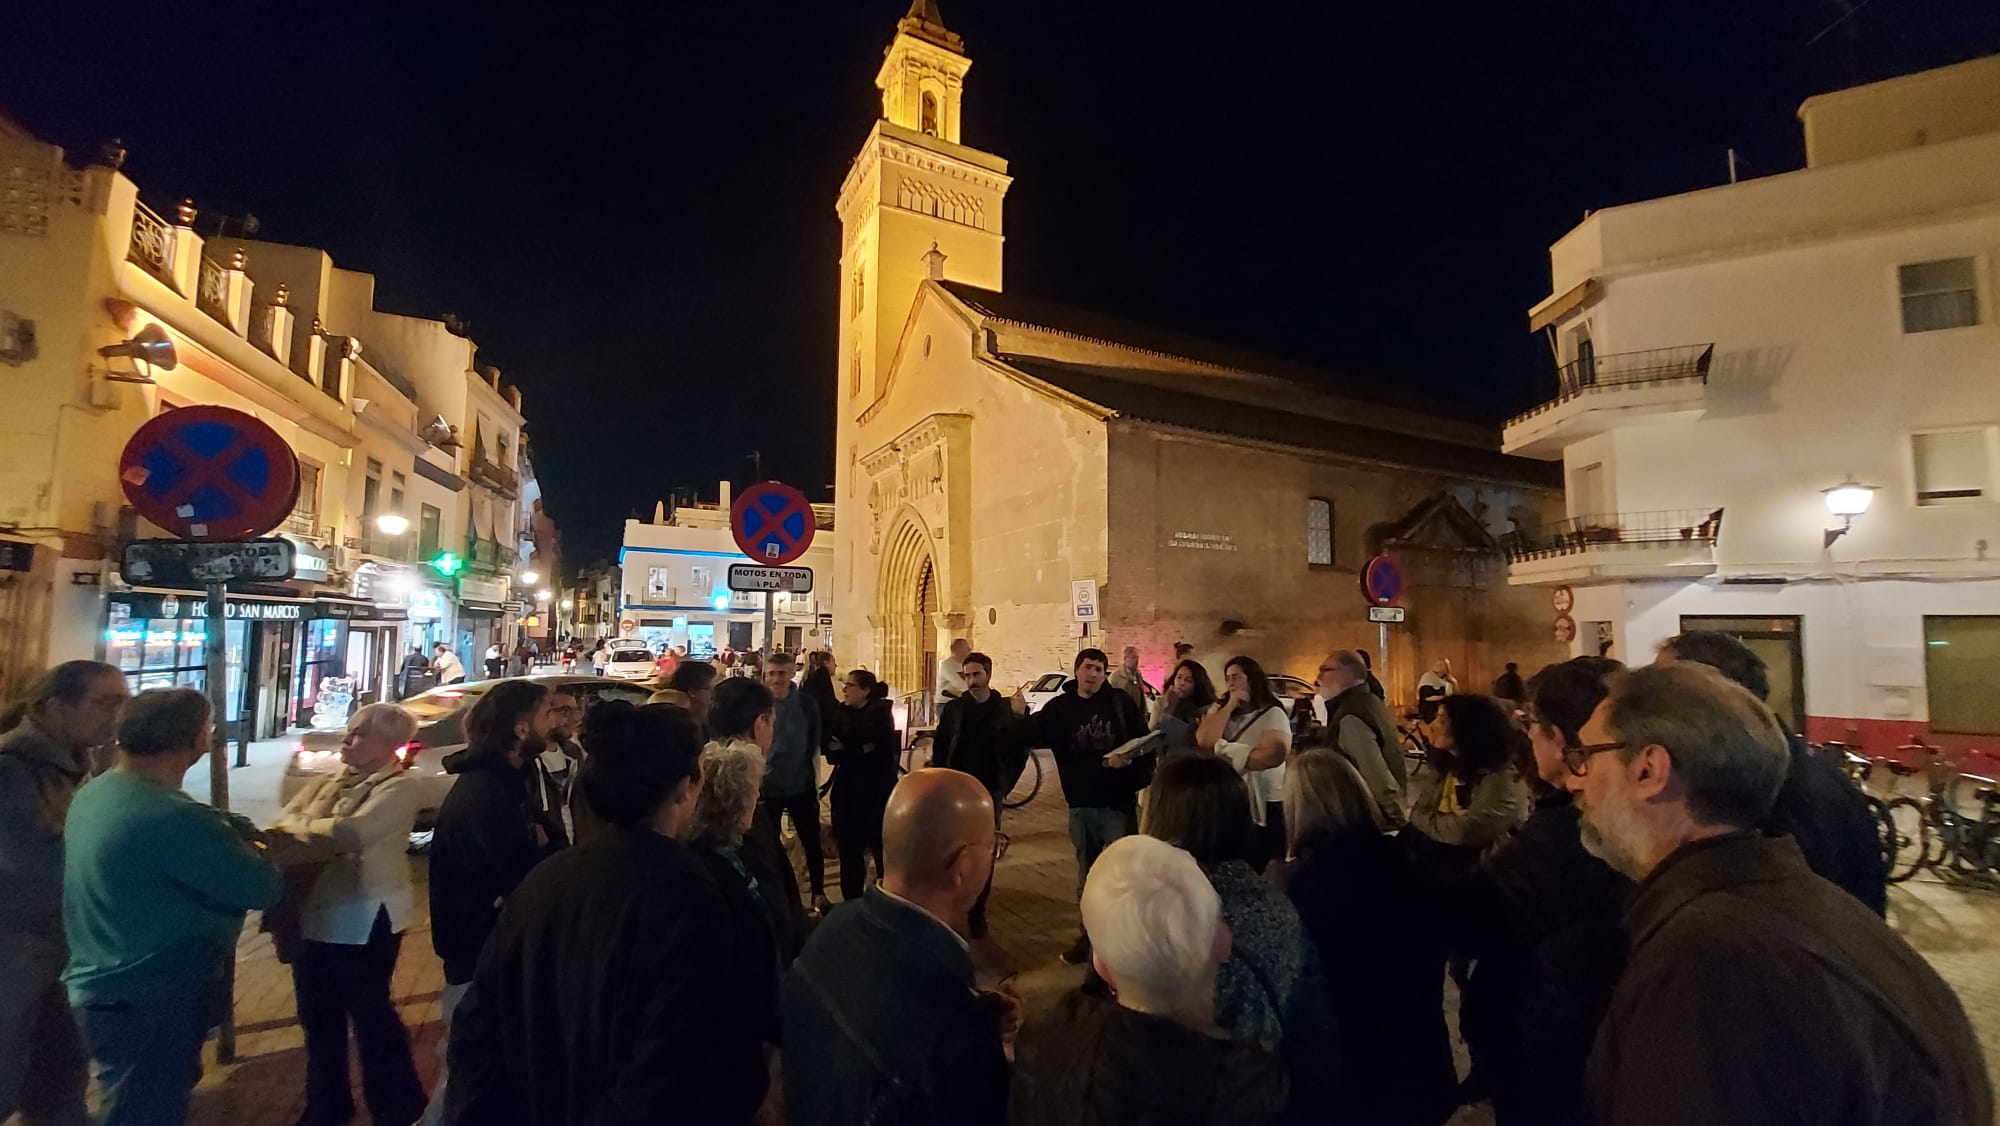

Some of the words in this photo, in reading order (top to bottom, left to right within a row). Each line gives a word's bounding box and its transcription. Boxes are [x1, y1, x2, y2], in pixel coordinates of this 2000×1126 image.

[734, 569, 767, 578] MOTOS
[240, 603, 260, 618] SAN
[263, 604, 300, 618] MARCOS
